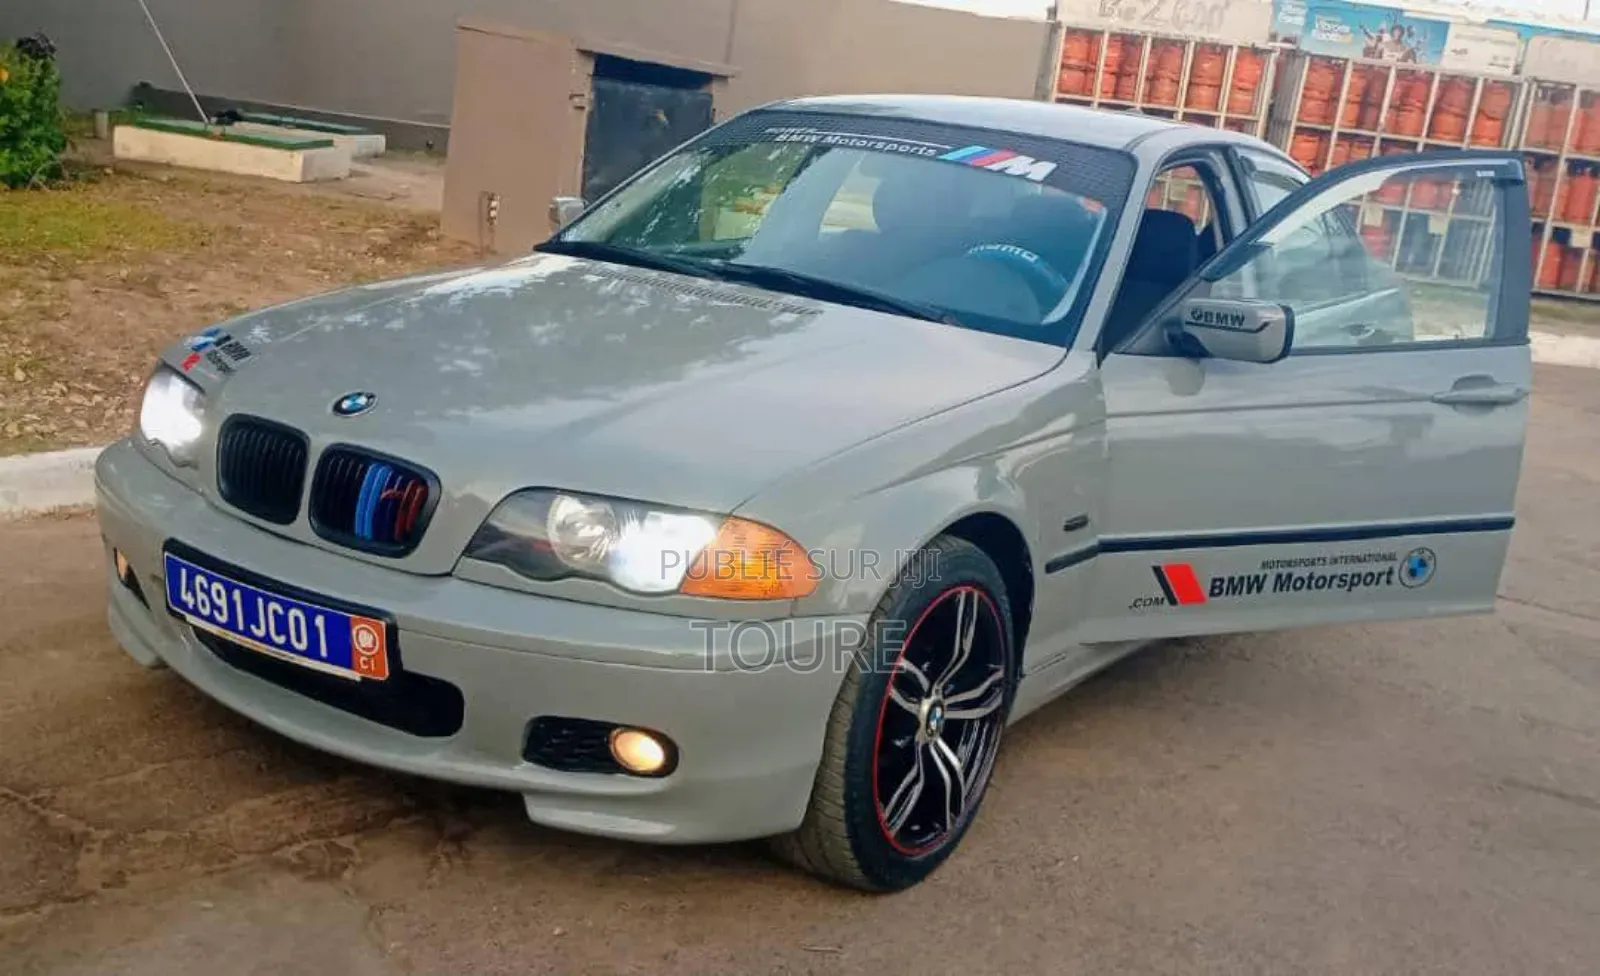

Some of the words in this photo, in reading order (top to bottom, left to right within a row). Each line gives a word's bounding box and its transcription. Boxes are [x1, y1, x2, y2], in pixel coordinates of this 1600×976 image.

[823, 134, 938, 157] Motorsports
[1204, 311, 1246, 326] BMW
[1209, 574, 1266, 598] BMW
[1272, 567, 1393, 592] Motorsport
